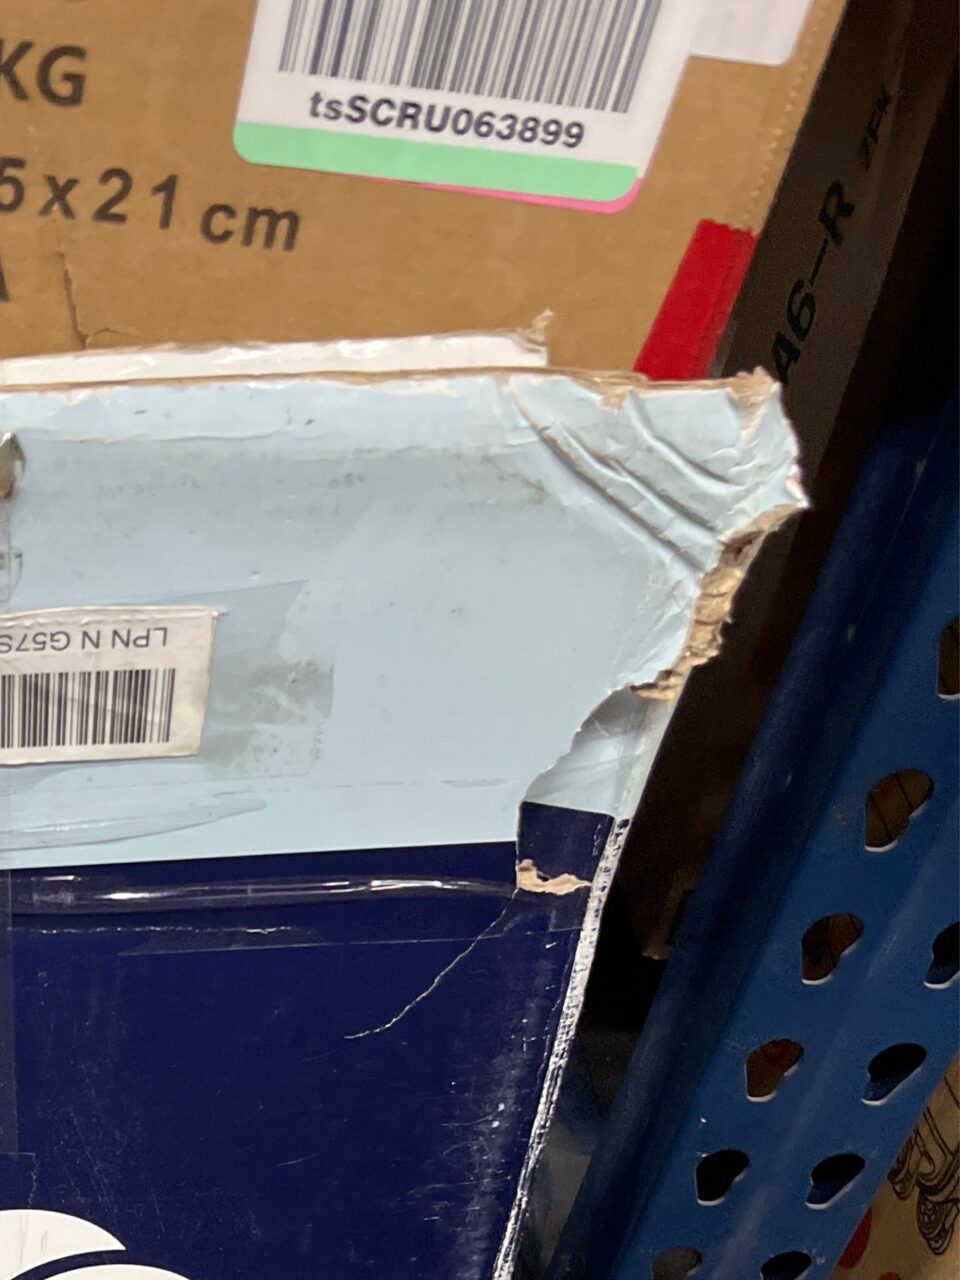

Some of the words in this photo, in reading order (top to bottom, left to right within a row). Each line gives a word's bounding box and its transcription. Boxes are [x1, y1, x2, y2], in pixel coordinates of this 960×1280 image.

[308, 90, 586, 150] tsSCRU063899
[199, 200, 301, 253] cm
[81, 631, 100, 651] N
[111, 626, 169, 650] LPN
